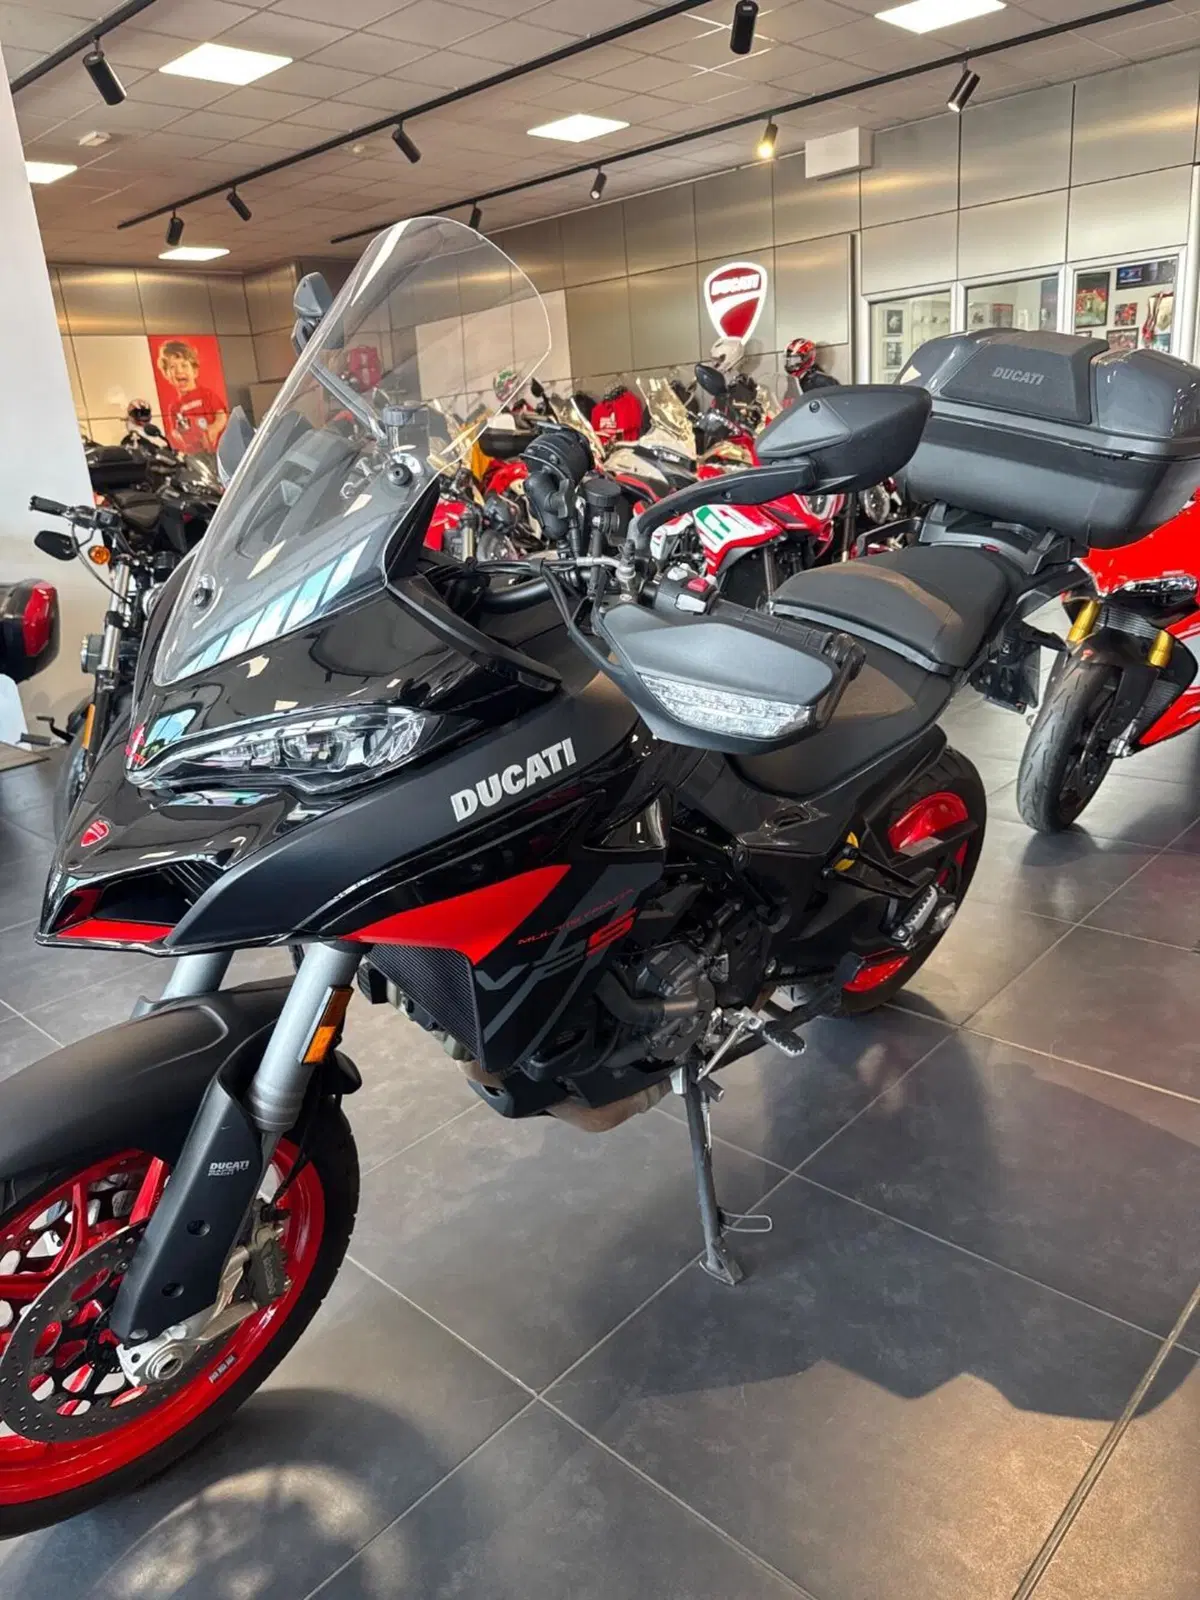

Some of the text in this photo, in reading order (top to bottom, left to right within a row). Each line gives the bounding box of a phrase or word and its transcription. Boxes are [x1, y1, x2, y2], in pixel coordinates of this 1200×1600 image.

[992, 366, 1045, 385] DUCATI
[450, 737, 577, 823] DUCATI
[210, 1160, 250, 1171] DUCATI
